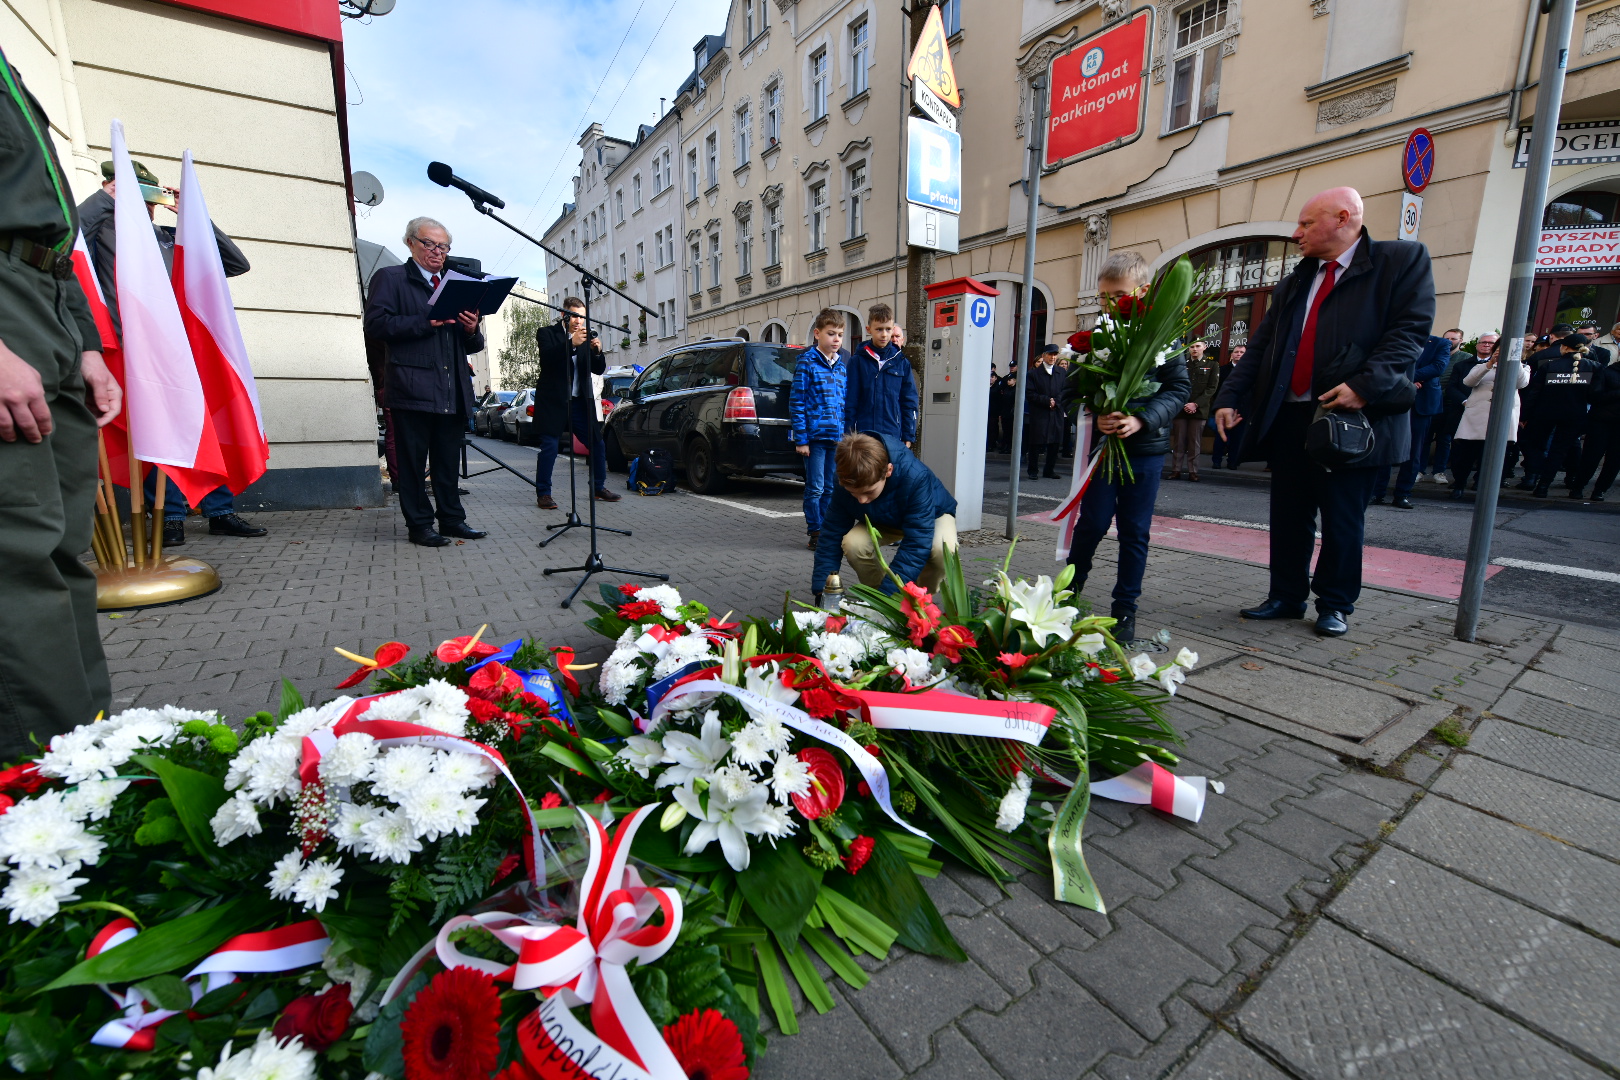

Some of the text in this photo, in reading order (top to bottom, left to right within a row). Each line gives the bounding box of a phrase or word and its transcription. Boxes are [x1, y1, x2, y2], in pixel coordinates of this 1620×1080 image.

[1086, 52, 1098, 62] PE
[1086, 60, 1097, 70] KA
[1062, 59, 1129, 102] Automat
[921, 89, 952, 129] KONTRAPAS
[1051, 82, 1138, 132] parkingowy
[920, 127, 951, 195] P
[930, 190, 958, 209] płatny
[1405, 209, 1416, 227] 30
[1541, 231, 1620, 242] PYSZNE
[1537, 243, 1620, 254] OBIADY
[975, 301, 988, 323] P
[1229, 337, 1248, 347] BAR
[775, 707, 808, 724] AND
